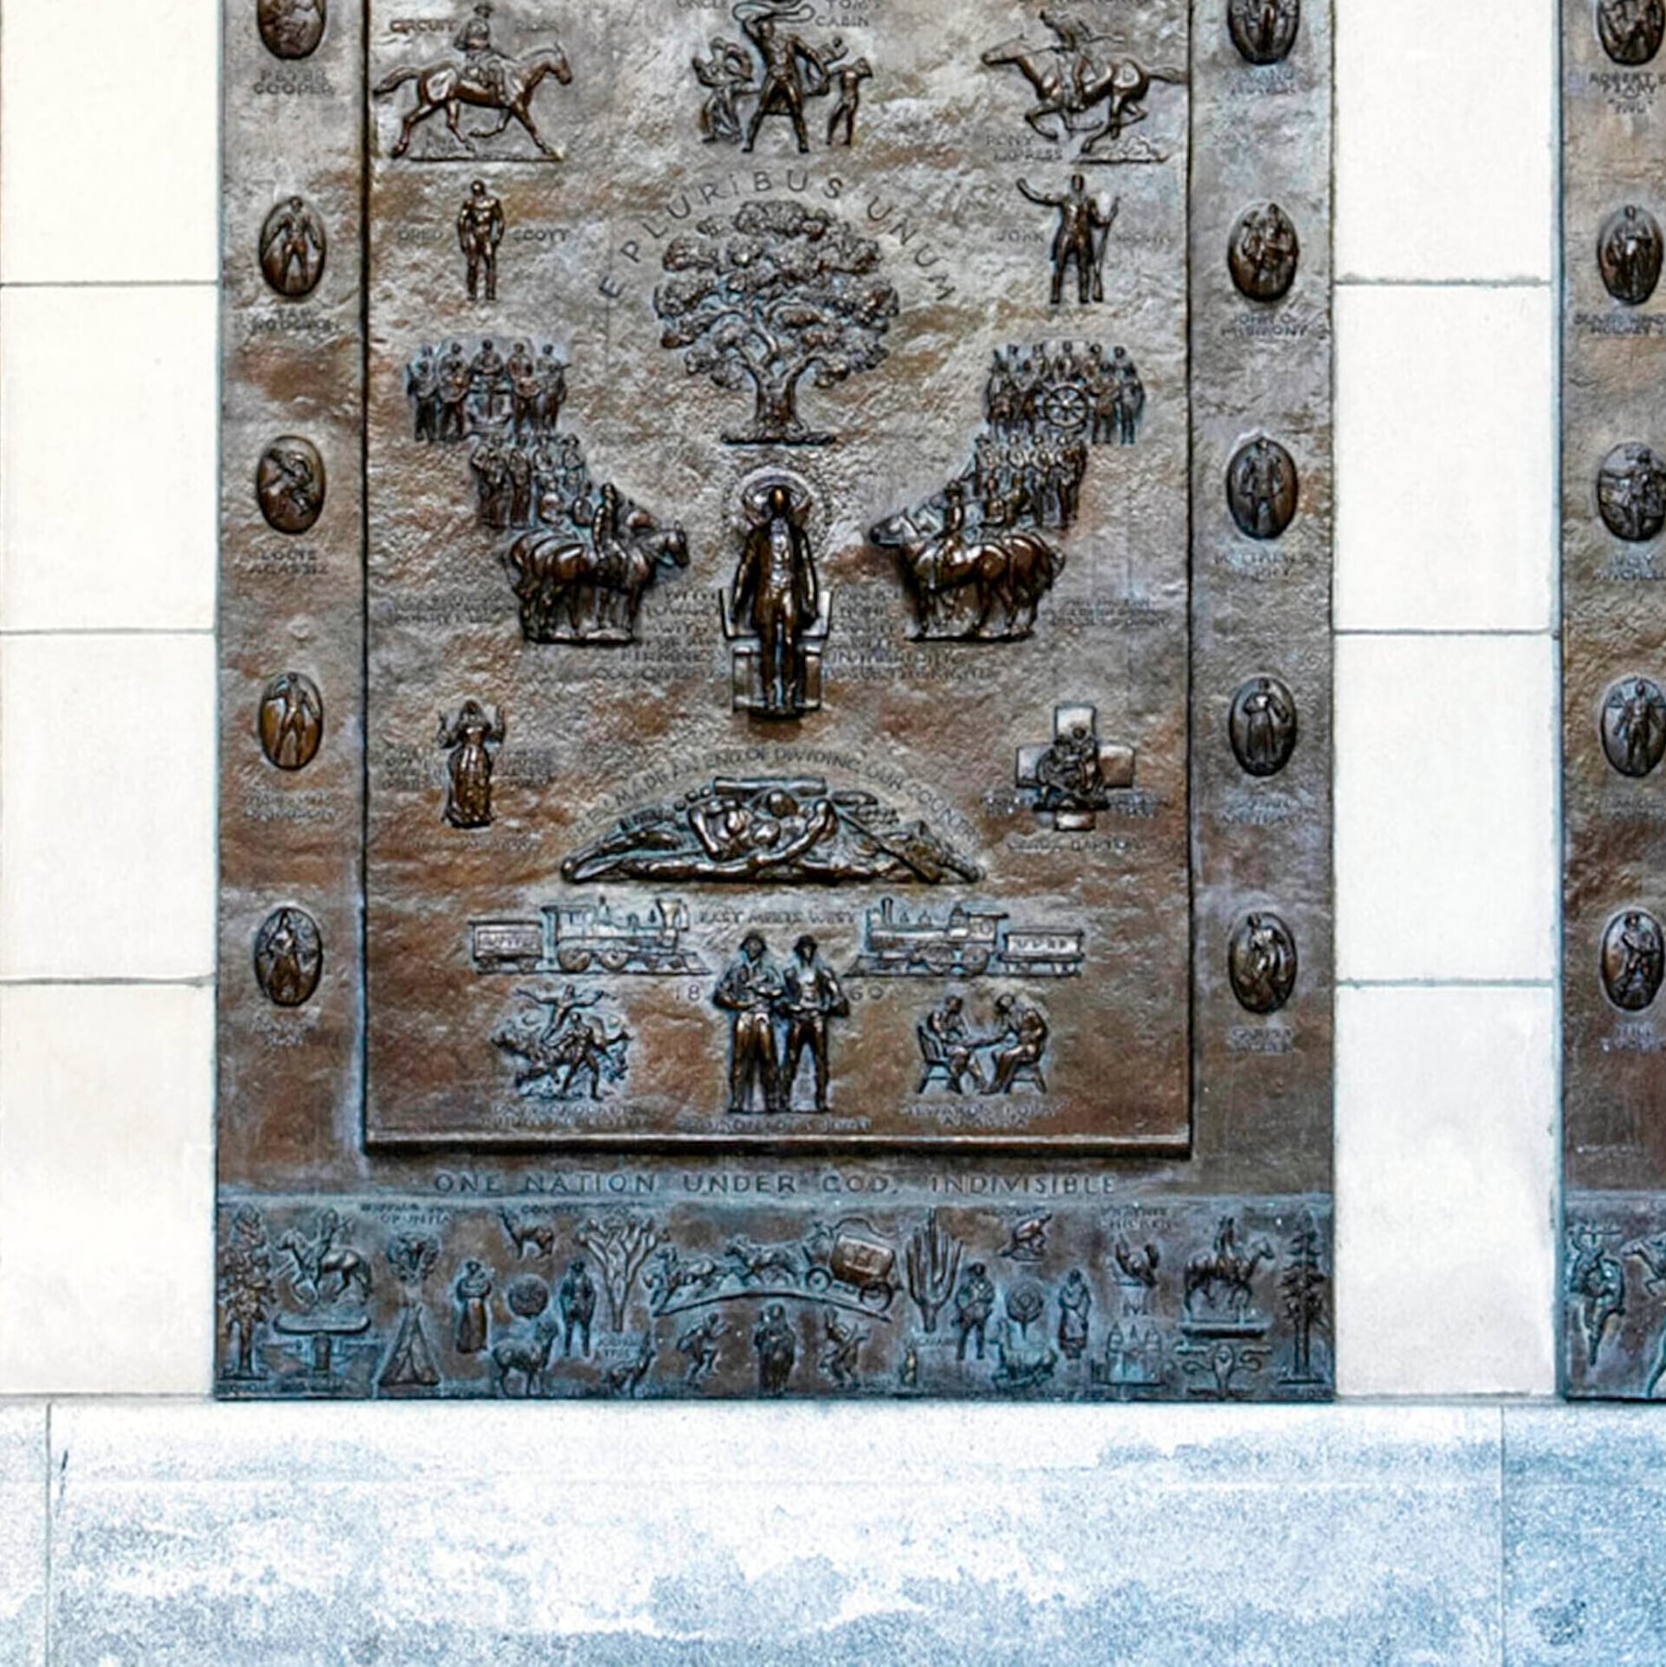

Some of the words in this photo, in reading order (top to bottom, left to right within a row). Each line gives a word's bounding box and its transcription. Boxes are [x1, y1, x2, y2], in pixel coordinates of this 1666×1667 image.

[598, 275, 625, 301] E
[619, 169, 844, 264] PLURIBUS
[865, 195, 958, 303] UNUM
[435, 1173, 503, 1193] ONE
[526, 1173, 656, 1193] NATION
[683, 1173, 797, 1193] UNDER
[932, 1174, 1117, 1195] INDIVISIBLE
